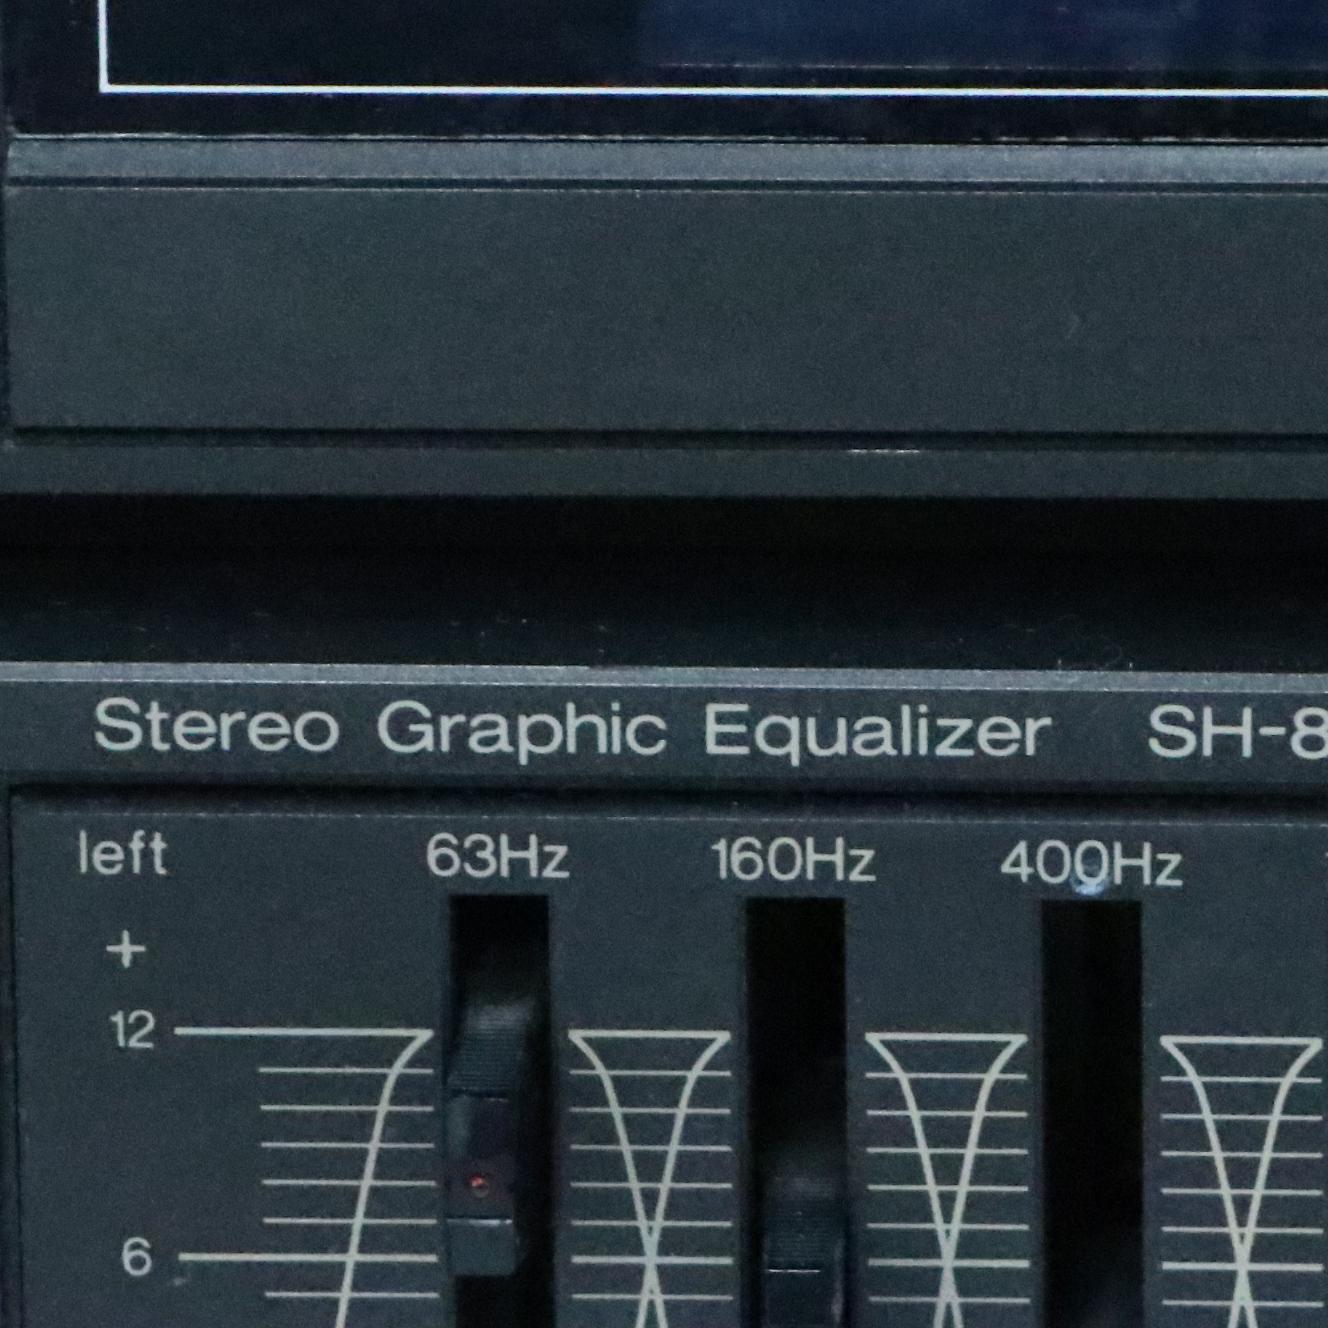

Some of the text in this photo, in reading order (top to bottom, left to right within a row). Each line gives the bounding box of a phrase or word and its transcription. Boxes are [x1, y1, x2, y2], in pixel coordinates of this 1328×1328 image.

[95, 696, 340, 752] Stereo
[377, 699, 667, 766] Graphic
[705, 702, 1052, 767] Equalizer
[78, 829, 168, 876] left
[426, 832, 570, 879] 63Hz
[711, 836, 877, 882] 160Hz
[1000, 839, 1183, 887] 400Hz
[110, 1009, 156, 1049] 12
[121, 1236, 153, 1277] 6
